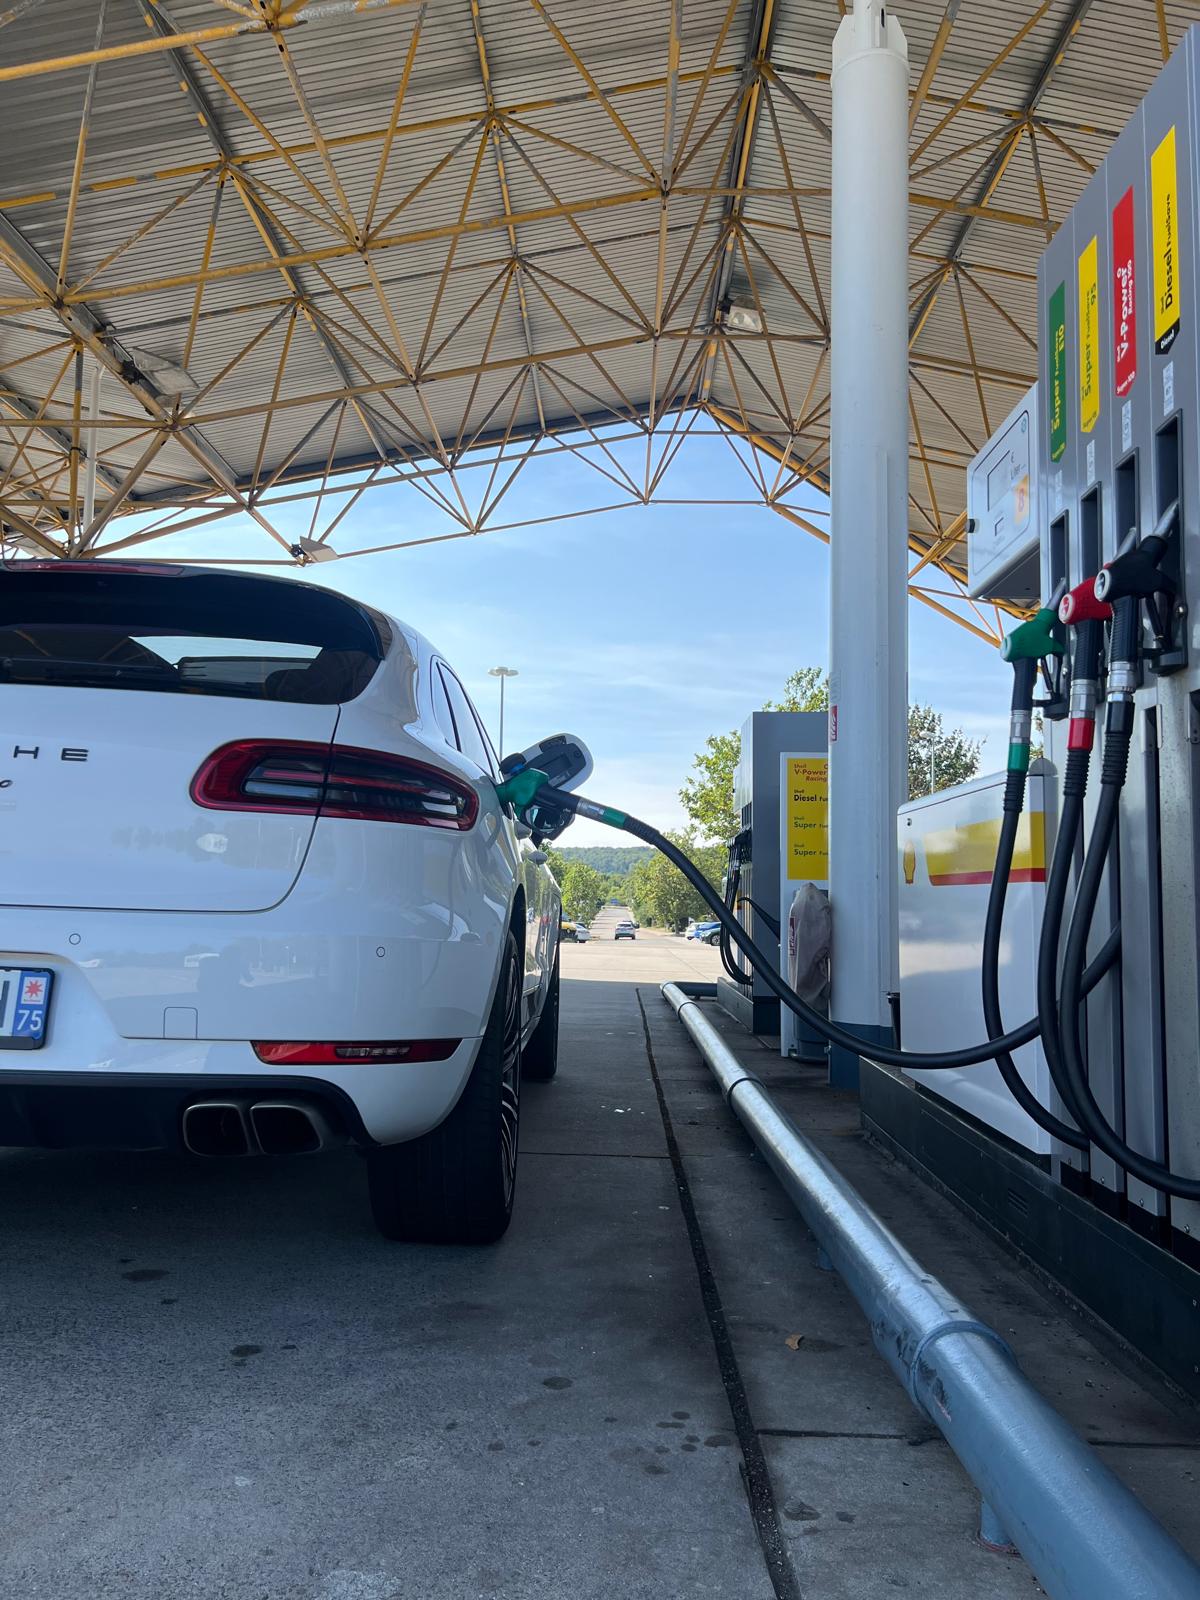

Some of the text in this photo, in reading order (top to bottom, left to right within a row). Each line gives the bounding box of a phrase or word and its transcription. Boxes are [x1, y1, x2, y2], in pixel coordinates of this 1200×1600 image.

[1163, 247, 1173, 310] Diesel
[1090, 282, 1097, 306] 95
[1120, 267, 1129, 358] V-Power
[1084, 343, 1092, 396] Super
[1053, 379, 1061, 431] Super
[793, 794, 817, 802] Diesel
[793, 821, 817, 829] Super
[793, 849, 817, 857] Super
[17, 1009, 43, 1031] 75
